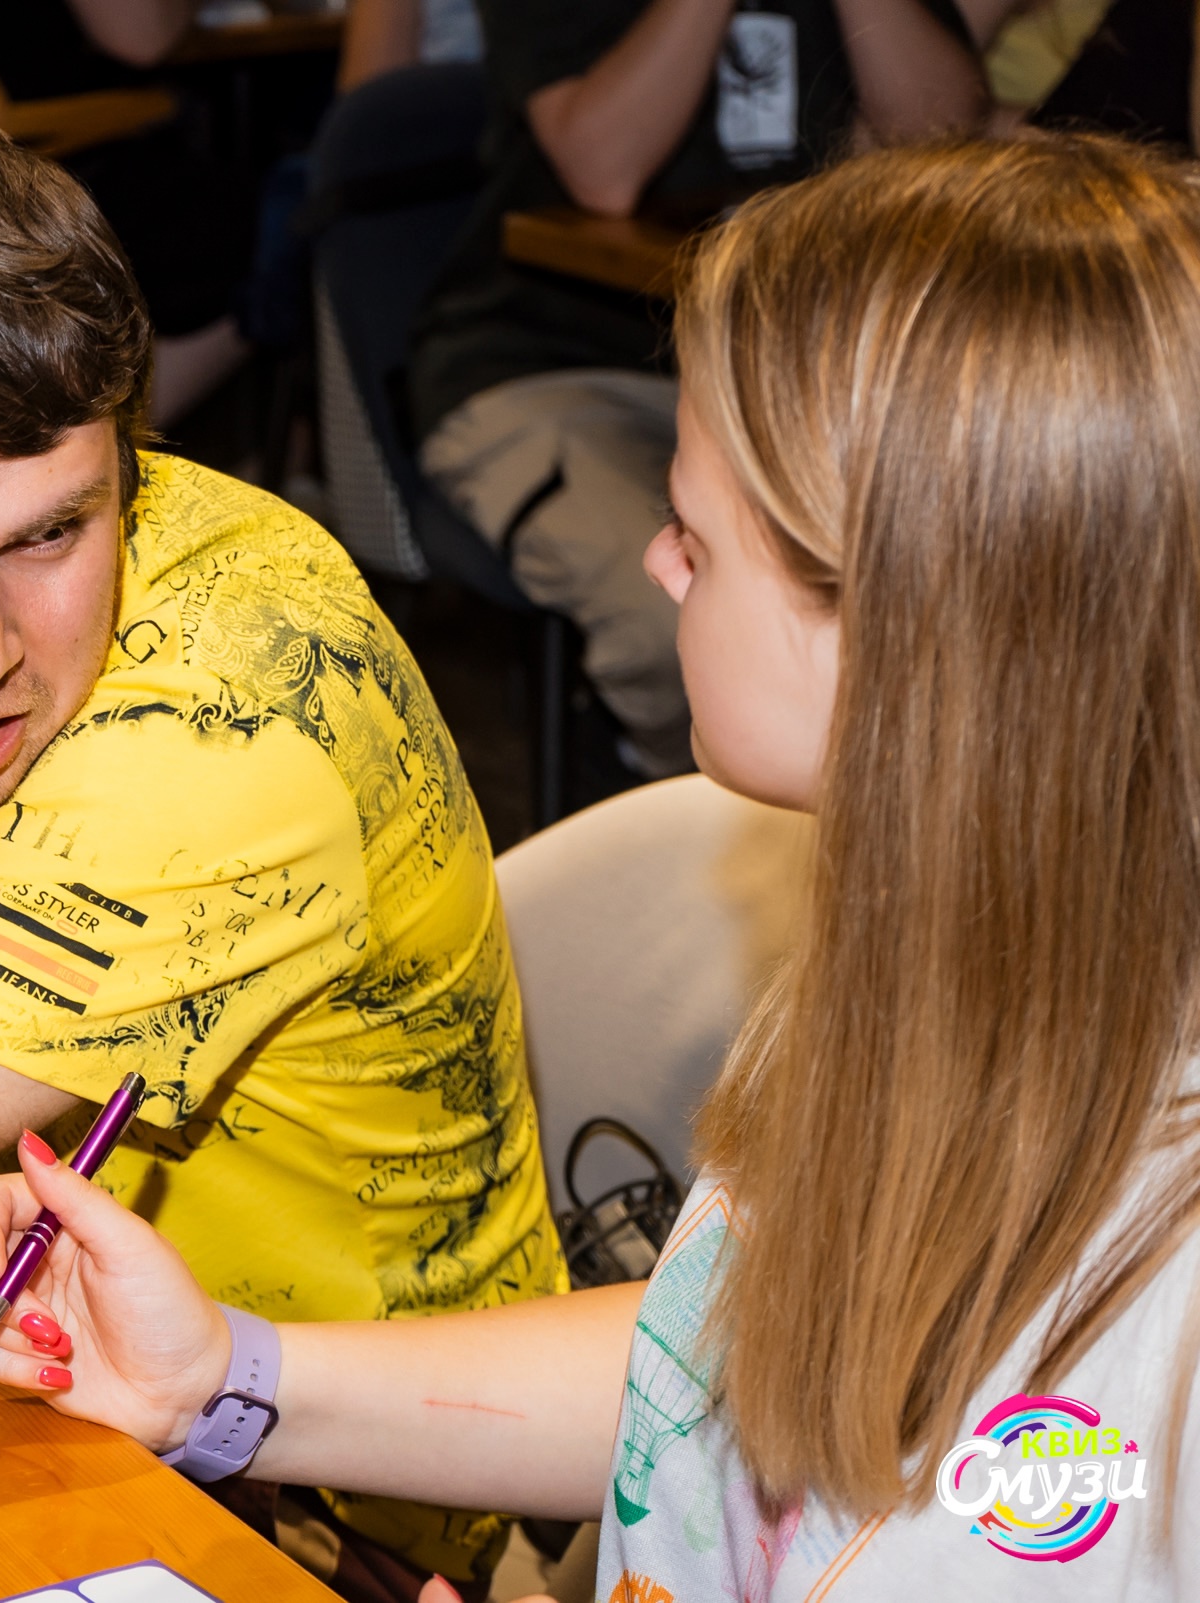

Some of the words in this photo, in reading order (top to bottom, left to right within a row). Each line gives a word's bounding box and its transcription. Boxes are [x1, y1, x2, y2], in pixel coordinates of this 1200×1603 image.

[34, 891, 100, 934] STYLER
[87, 892, 134, 920] CLUB
[0, 970, 59, 1007] JEANS
